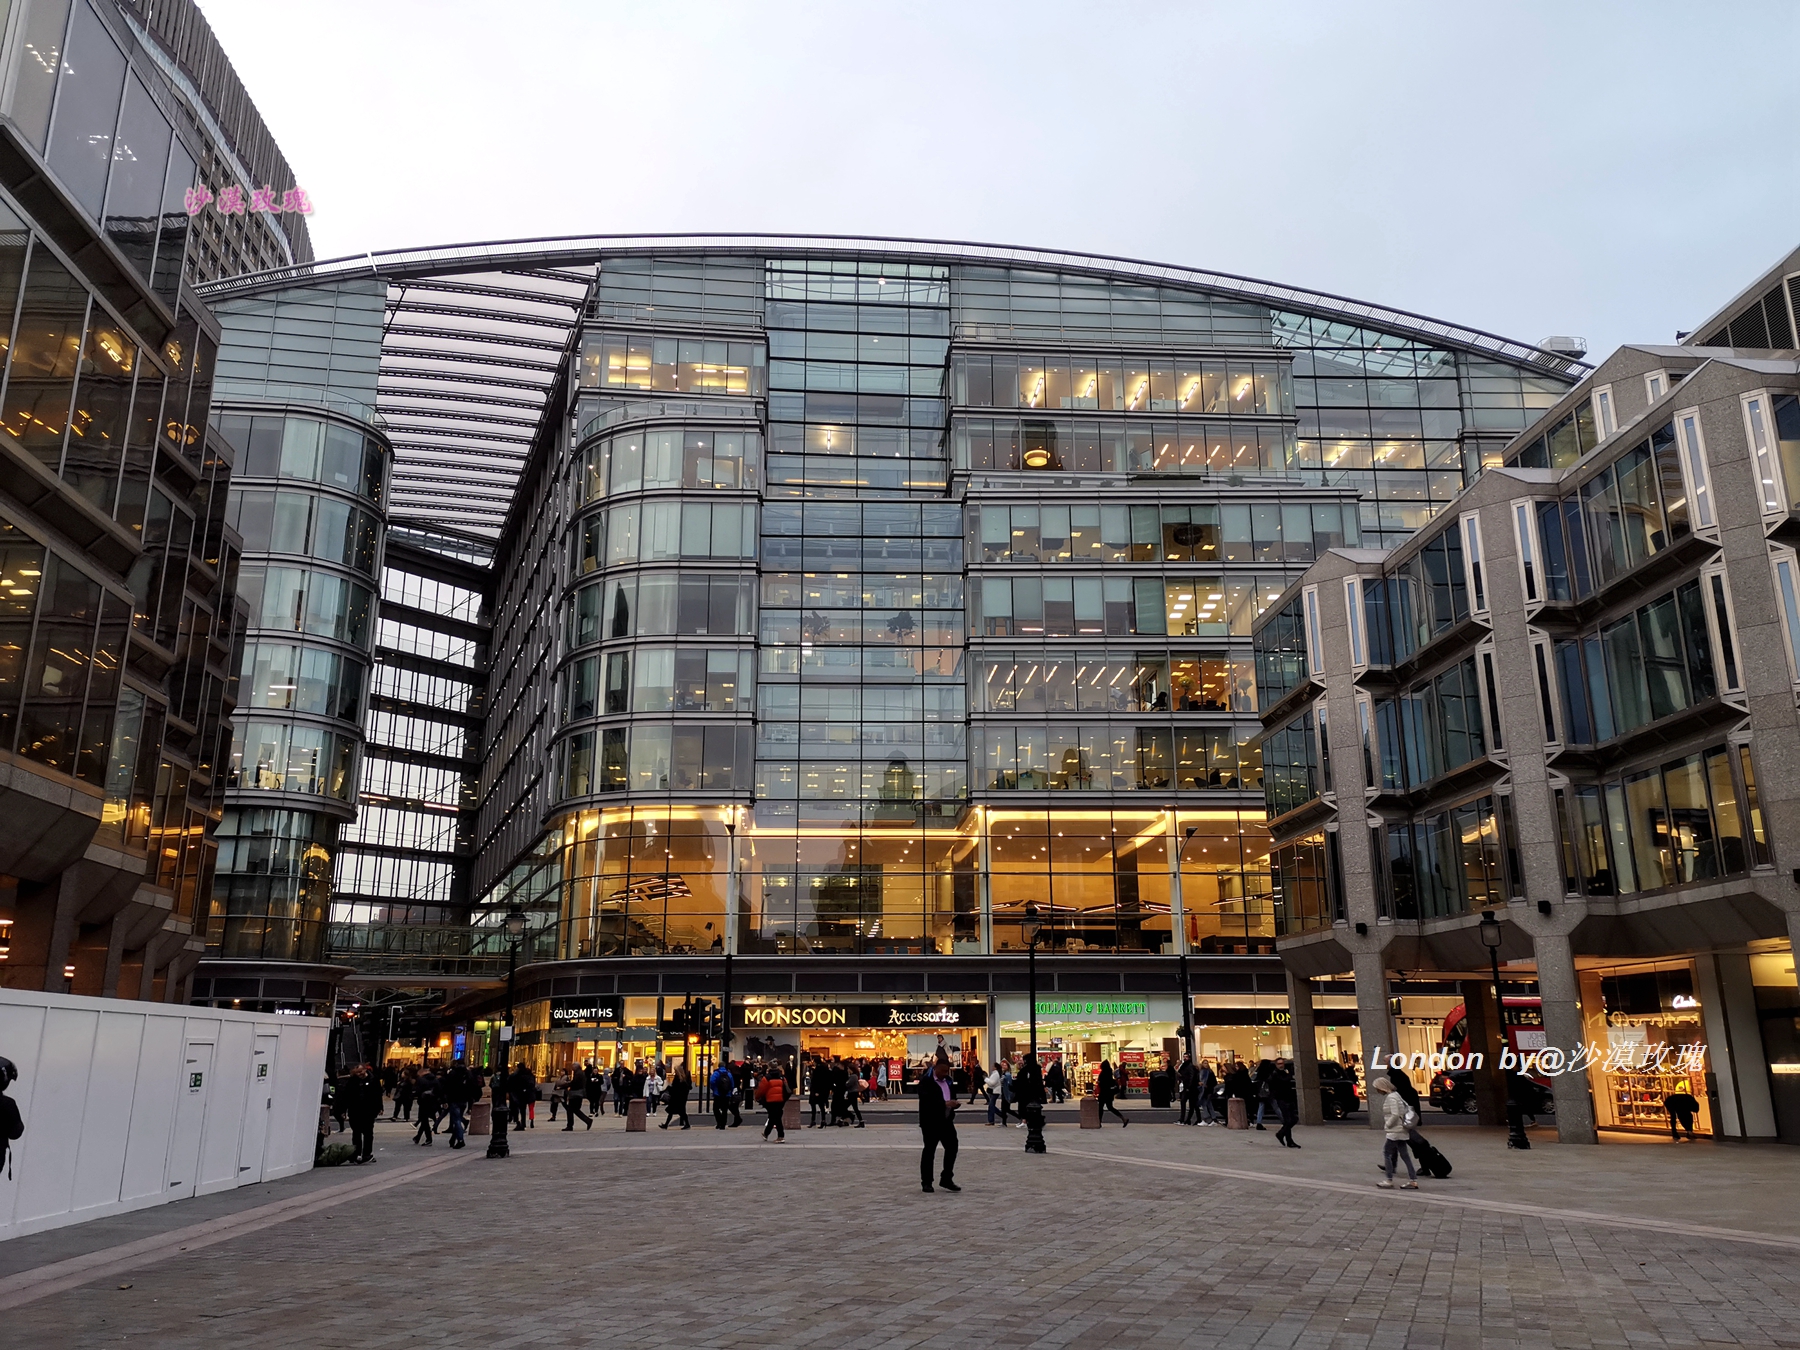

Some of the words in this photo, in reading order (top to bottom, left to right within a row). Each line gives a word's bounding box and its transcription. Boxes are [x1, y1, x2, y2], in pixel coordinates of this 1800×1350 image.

[553, 1008, 613, 1019] GOLDSMITHS
[887, 1006, 960, 1025] Accessorize
[1097, 1002, 1146, 1015] BARRETT
[744, 1008, 846, 1025] MONSOON
